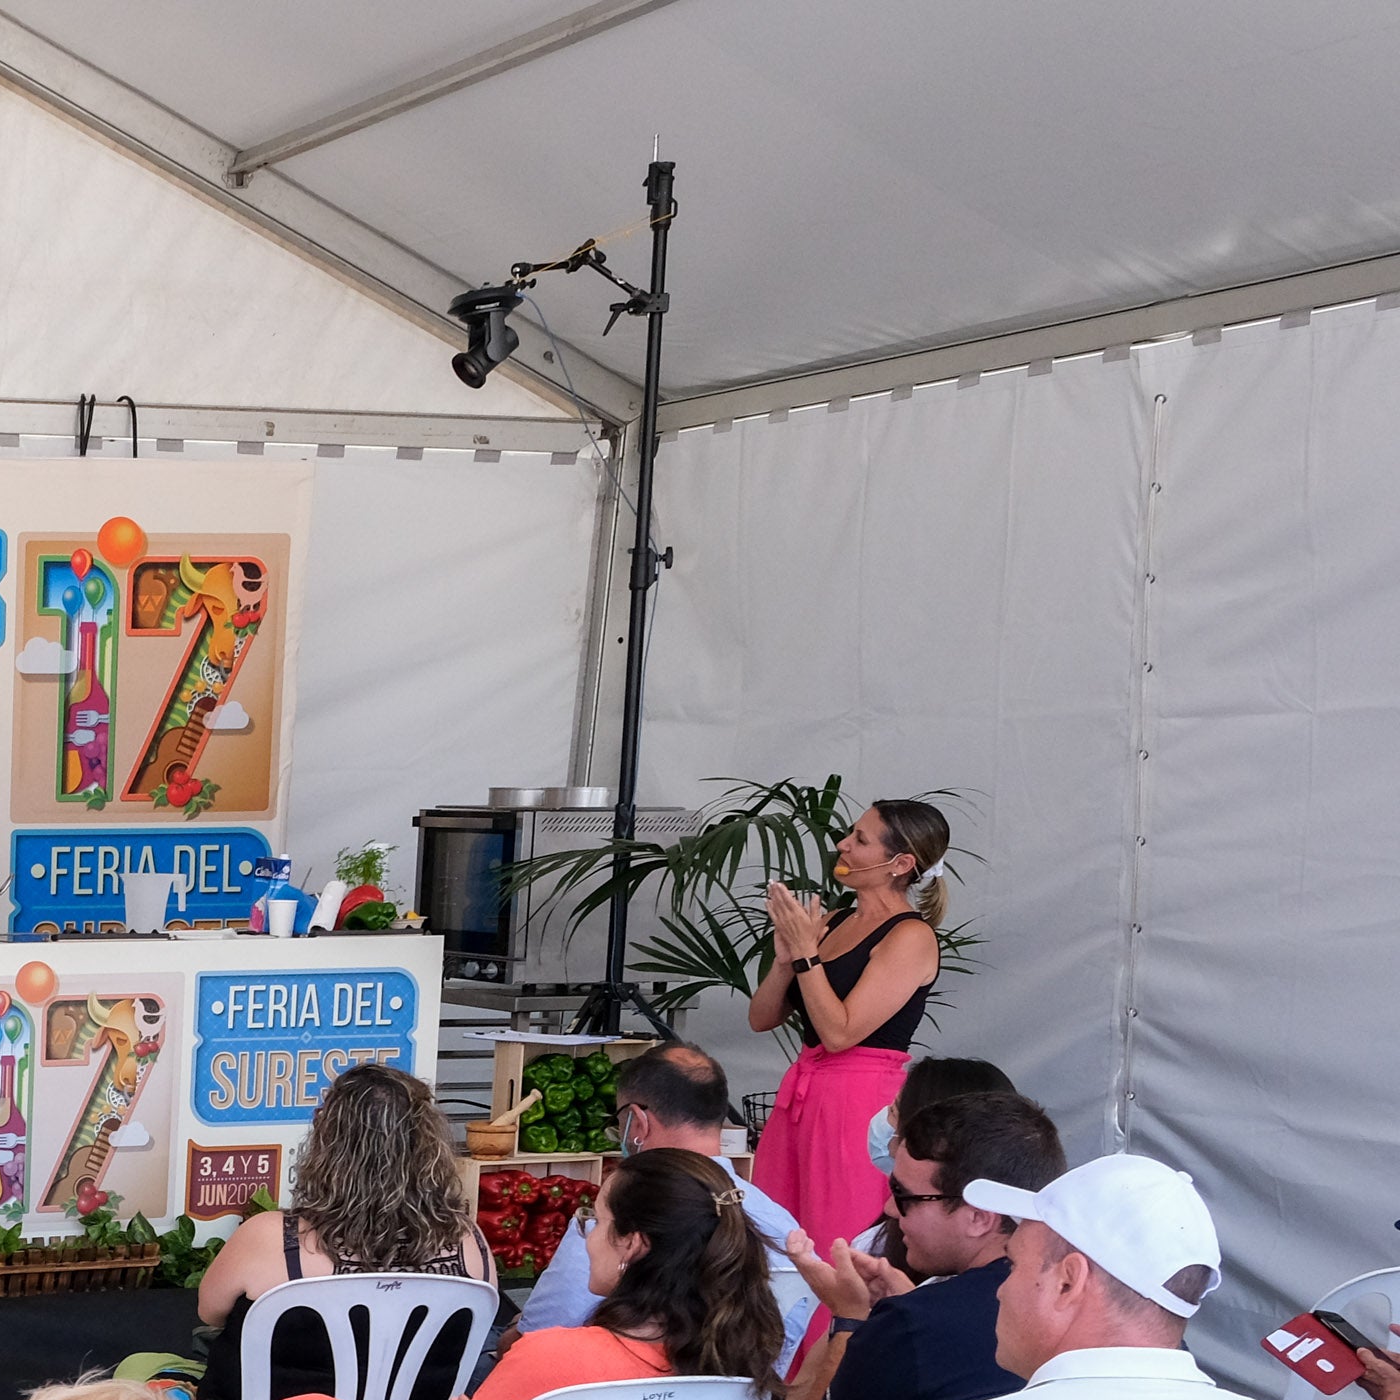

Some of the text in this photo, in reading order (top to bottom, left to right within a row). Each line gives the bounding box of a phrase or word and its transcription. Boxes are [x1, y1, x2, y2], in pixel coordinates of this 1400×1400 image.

[36, 553, 269, 804] 17
[173, 844, 242, 893] DEL
[227, 982, 392, 1030] FERIA DEL
[209, 1048, 400, 1111] SURES
[200, 1157, 217, 1178] 3,
[222, 1156, 235, 1175] 4
[240, 1155, 253, 1174] Y
[257, 1154, 269, 1174] 5
